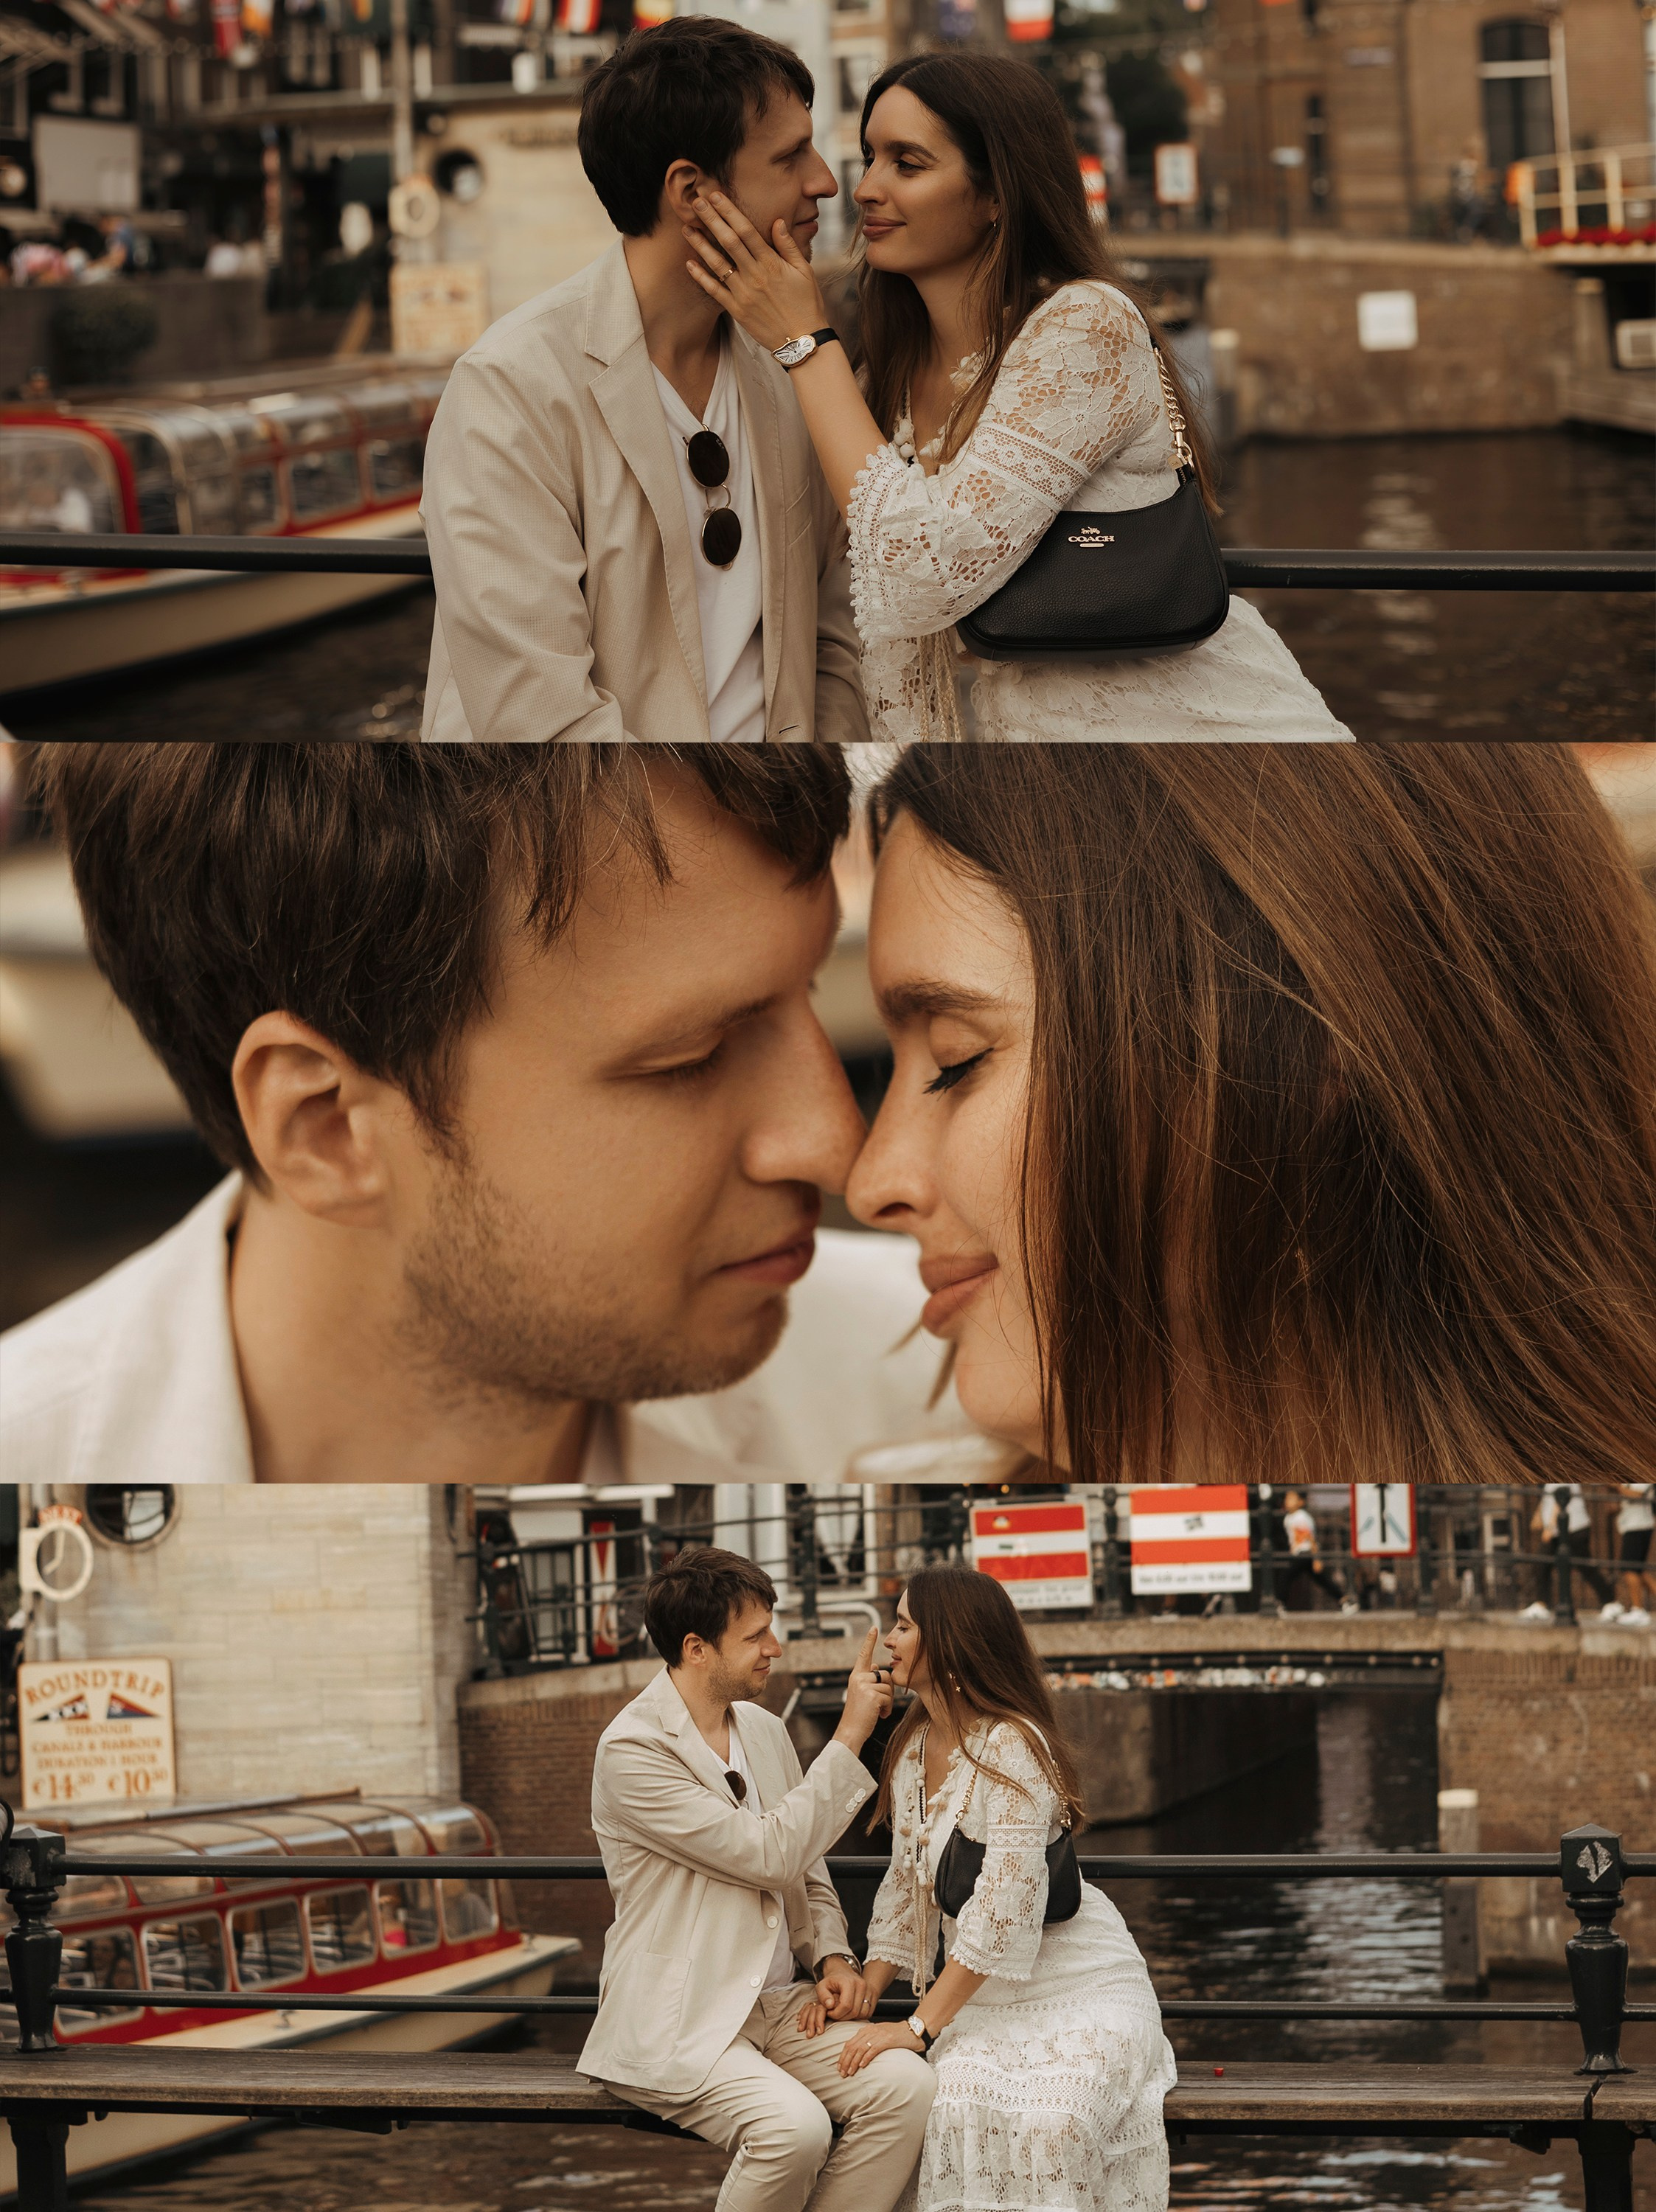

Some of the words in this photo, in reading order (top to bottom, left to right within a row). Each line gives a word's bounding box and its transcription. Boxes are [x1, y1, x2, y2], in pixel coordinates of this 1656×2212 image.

[24, 1669, 165, 1705] ROUNDTRIP
[66, 1723, 133, 1735] THROUGH
[32, 1741, 84, 1753] CANALS
[100, 1737, 162, 1750] HARBOUR
[38, 1756, 107, 1769] DURATION
[121, 1753, 157, 1765] HOUR
